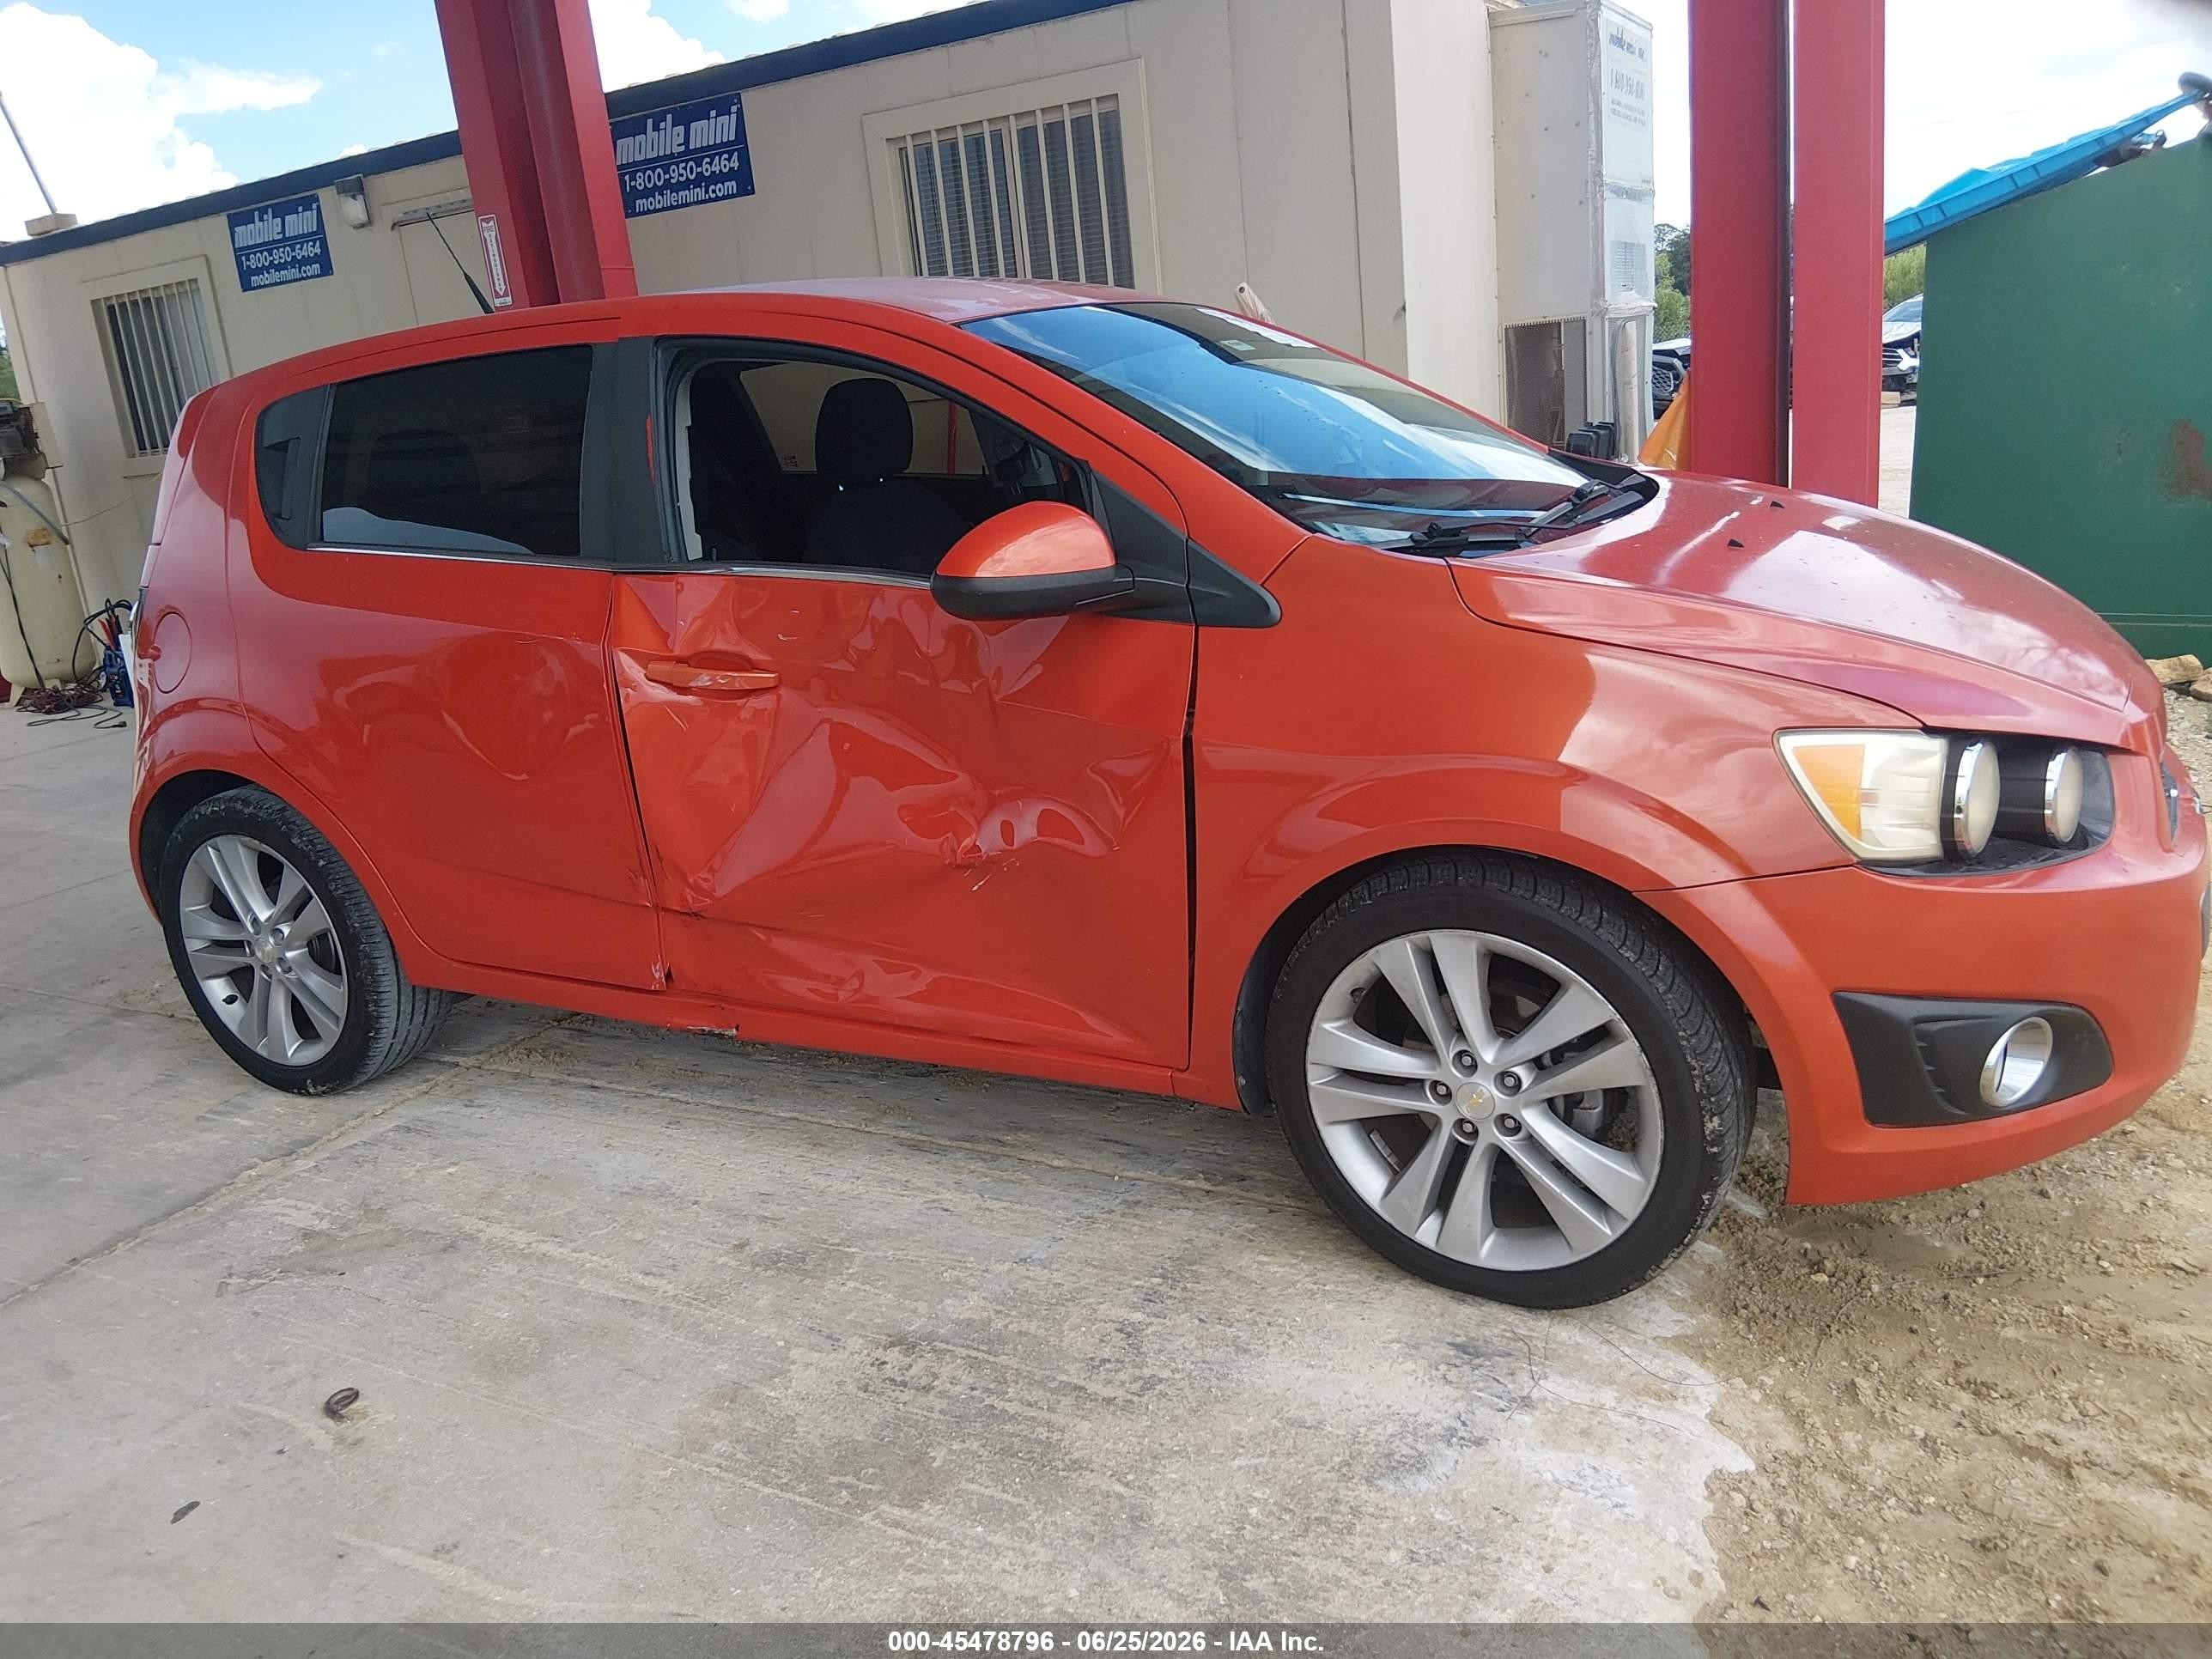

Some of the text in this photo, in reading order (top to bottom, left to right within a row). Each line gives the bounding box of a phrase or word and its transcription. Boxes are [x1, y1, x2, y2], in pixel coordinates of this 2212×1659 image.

[617, 106, 737, 165] mobile mini
[625, 152, 738, 192] 1-800-950-6464
[635, 181, 736, 212] mobilemini.com
[234, 206, 317, 247] mobile mini
[241, 241, 320, 270] 1-800-950-6464
[251, 264, 320, 287] mobilemini.com
